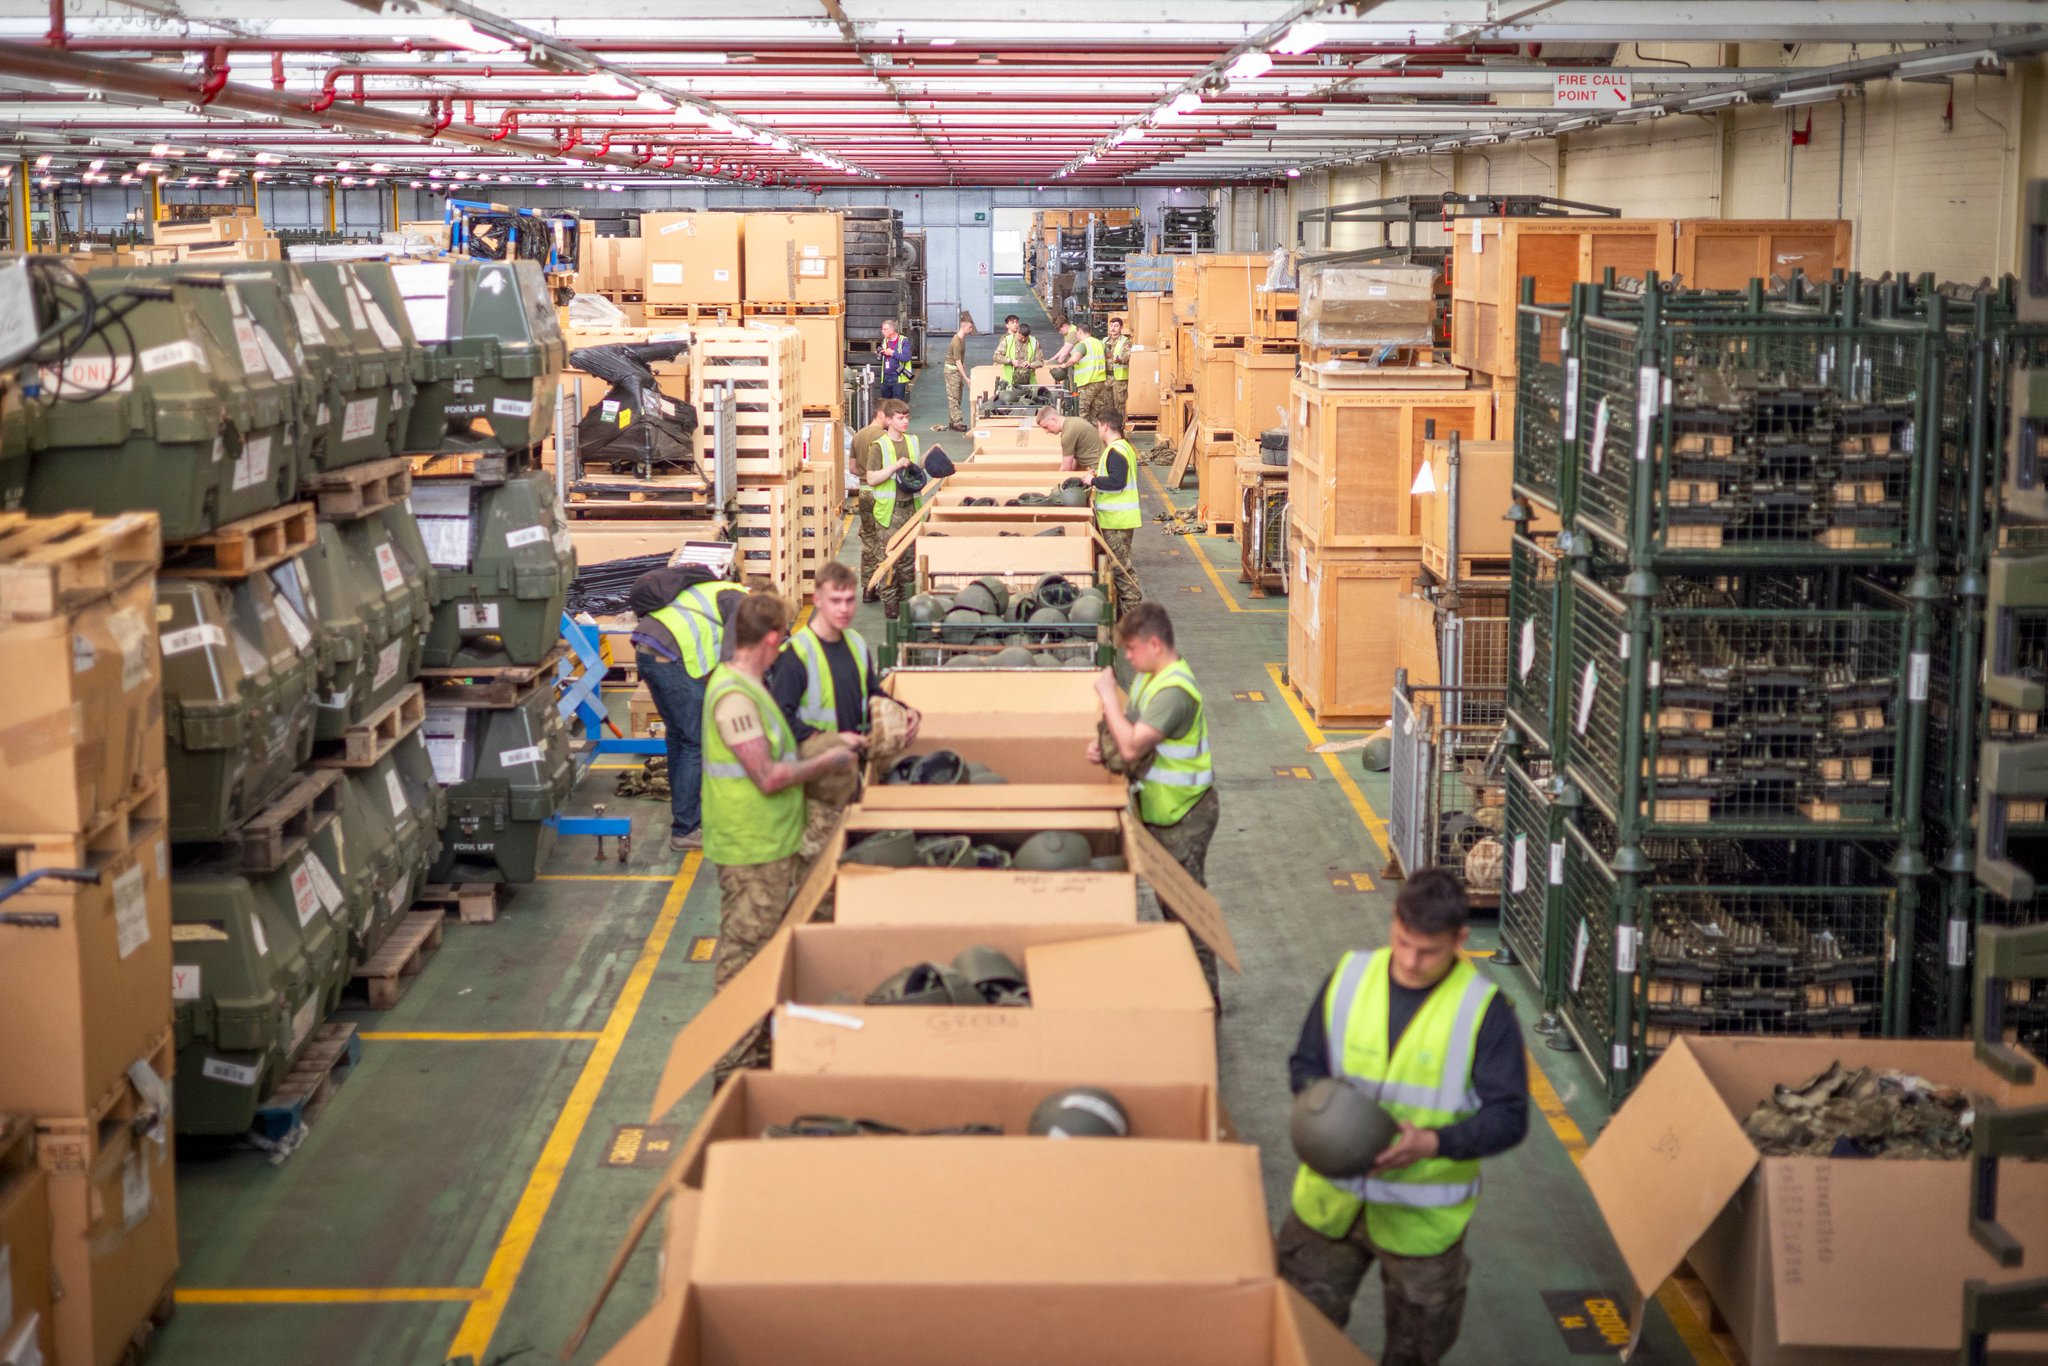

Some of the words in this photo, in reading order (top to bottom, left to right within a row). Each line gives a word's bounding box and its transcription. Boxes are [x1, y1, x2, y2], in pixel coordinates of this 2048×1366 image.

[1558, 75, 1587, 85] FIRE
[1592, 75, 1627, 85] CALL
[1558, 91, 1598, 101] POINT
[444, 405, 468, 413] FORK
[469, 403, 487, 412] LIFT
